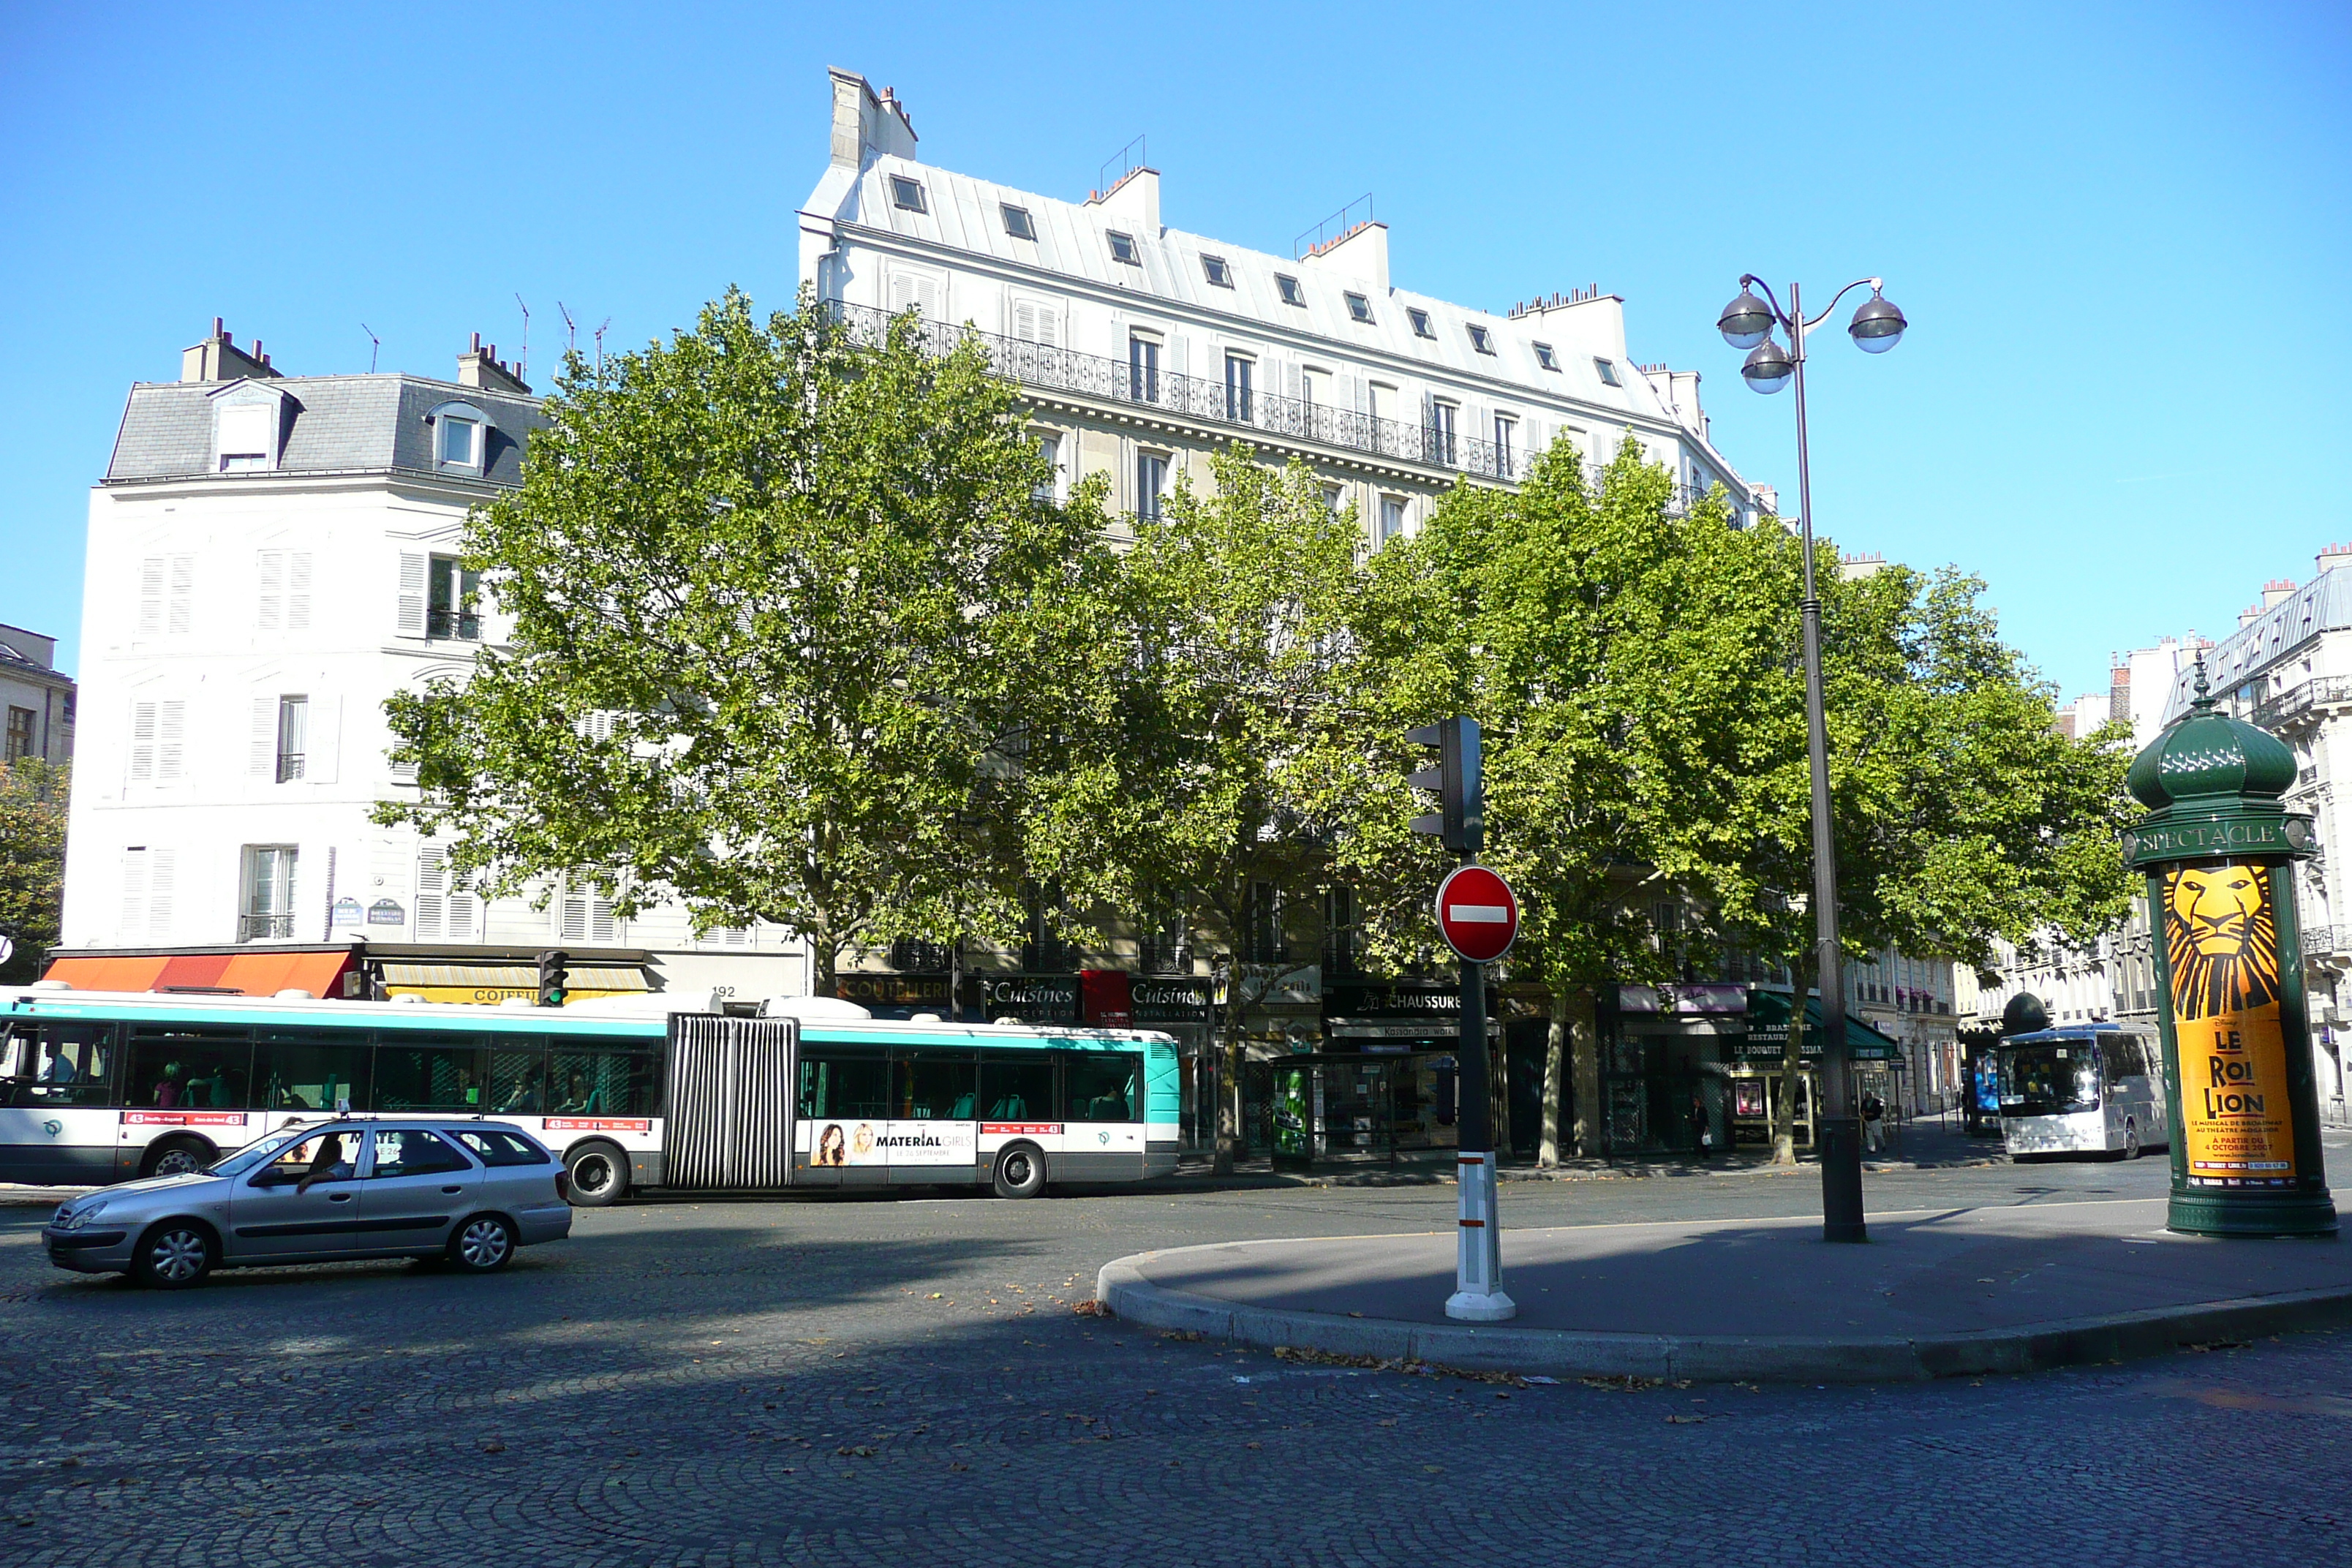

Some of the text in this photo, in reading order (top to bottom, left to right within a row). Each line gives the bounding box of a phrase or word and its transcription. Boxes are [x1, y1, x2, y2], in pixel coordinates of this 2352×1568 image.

[2142, 824, 2275, 852] SPECTACLE
[474, 990, 539, 1001] COIFFU
[712, 986, 735, 997] 192
[995, 981, 1074, 1003] Cuisines
[1132, 983, 1204, 1004] Cuisines
[995, 1009, 1075, 1017] CONCEPTION
[2215, 1031, 2242, 1049] LE
[1734, 1046, 1744, 1054] LE
[1747, 1046, 1782, 1055] BOUQUET
[2209, 1055, 2253, 1088] ROI
[2204, 1088, 2265, 1120] LION
[129, 1113, 145, 1123] 43
[225, 1115, 240, 1125] 43
[549, 1119, 562, 1129] 43
[1048, 1125, 1058, 1134] 43
[875, 1131, 972, 1147] MATERIAL GIRLS
